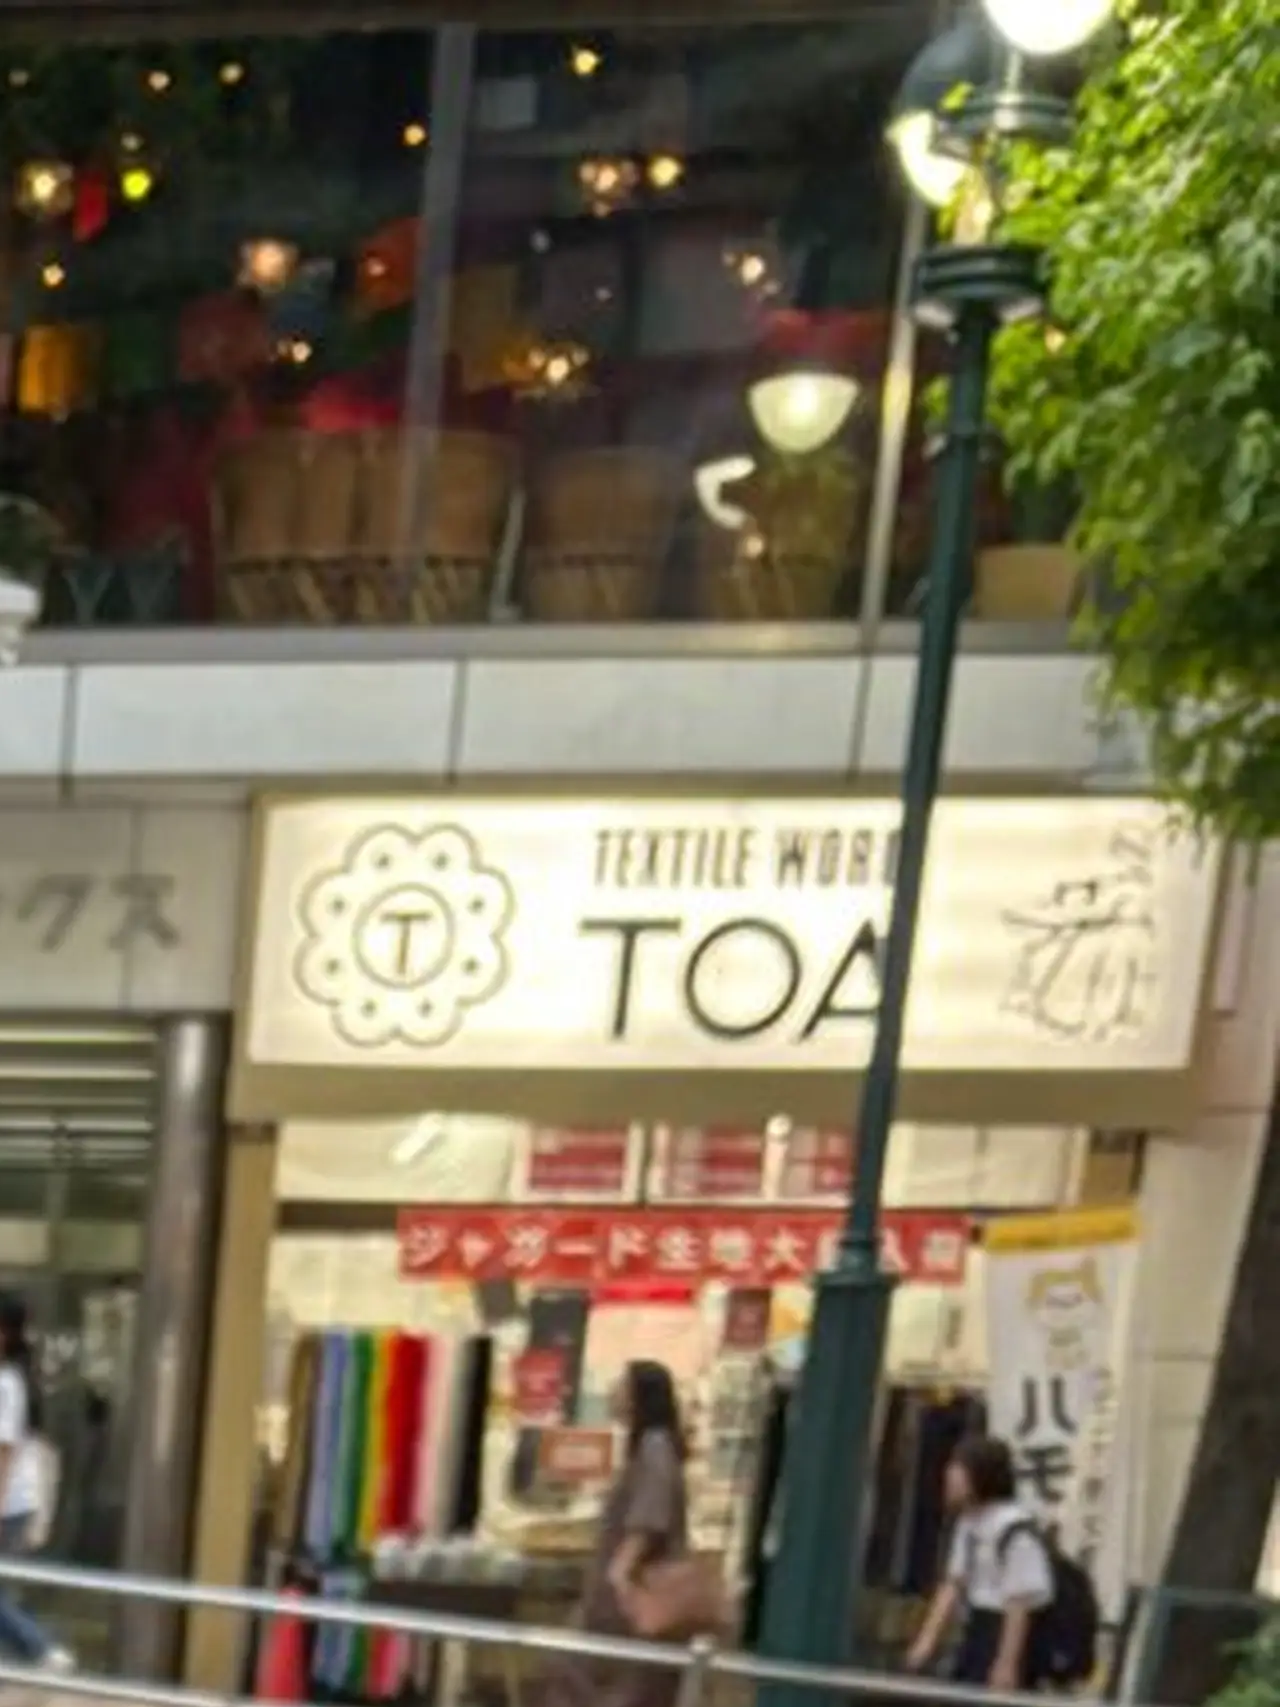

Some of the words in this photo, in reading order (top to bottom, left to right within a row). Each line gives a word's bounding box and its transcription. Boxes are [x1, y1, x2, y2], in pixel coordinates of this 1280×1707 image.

[595, 829, 754, 887] TEXTILE
[380, 909, 432, 976] T
[580, 918, 890, 1040] TOA
